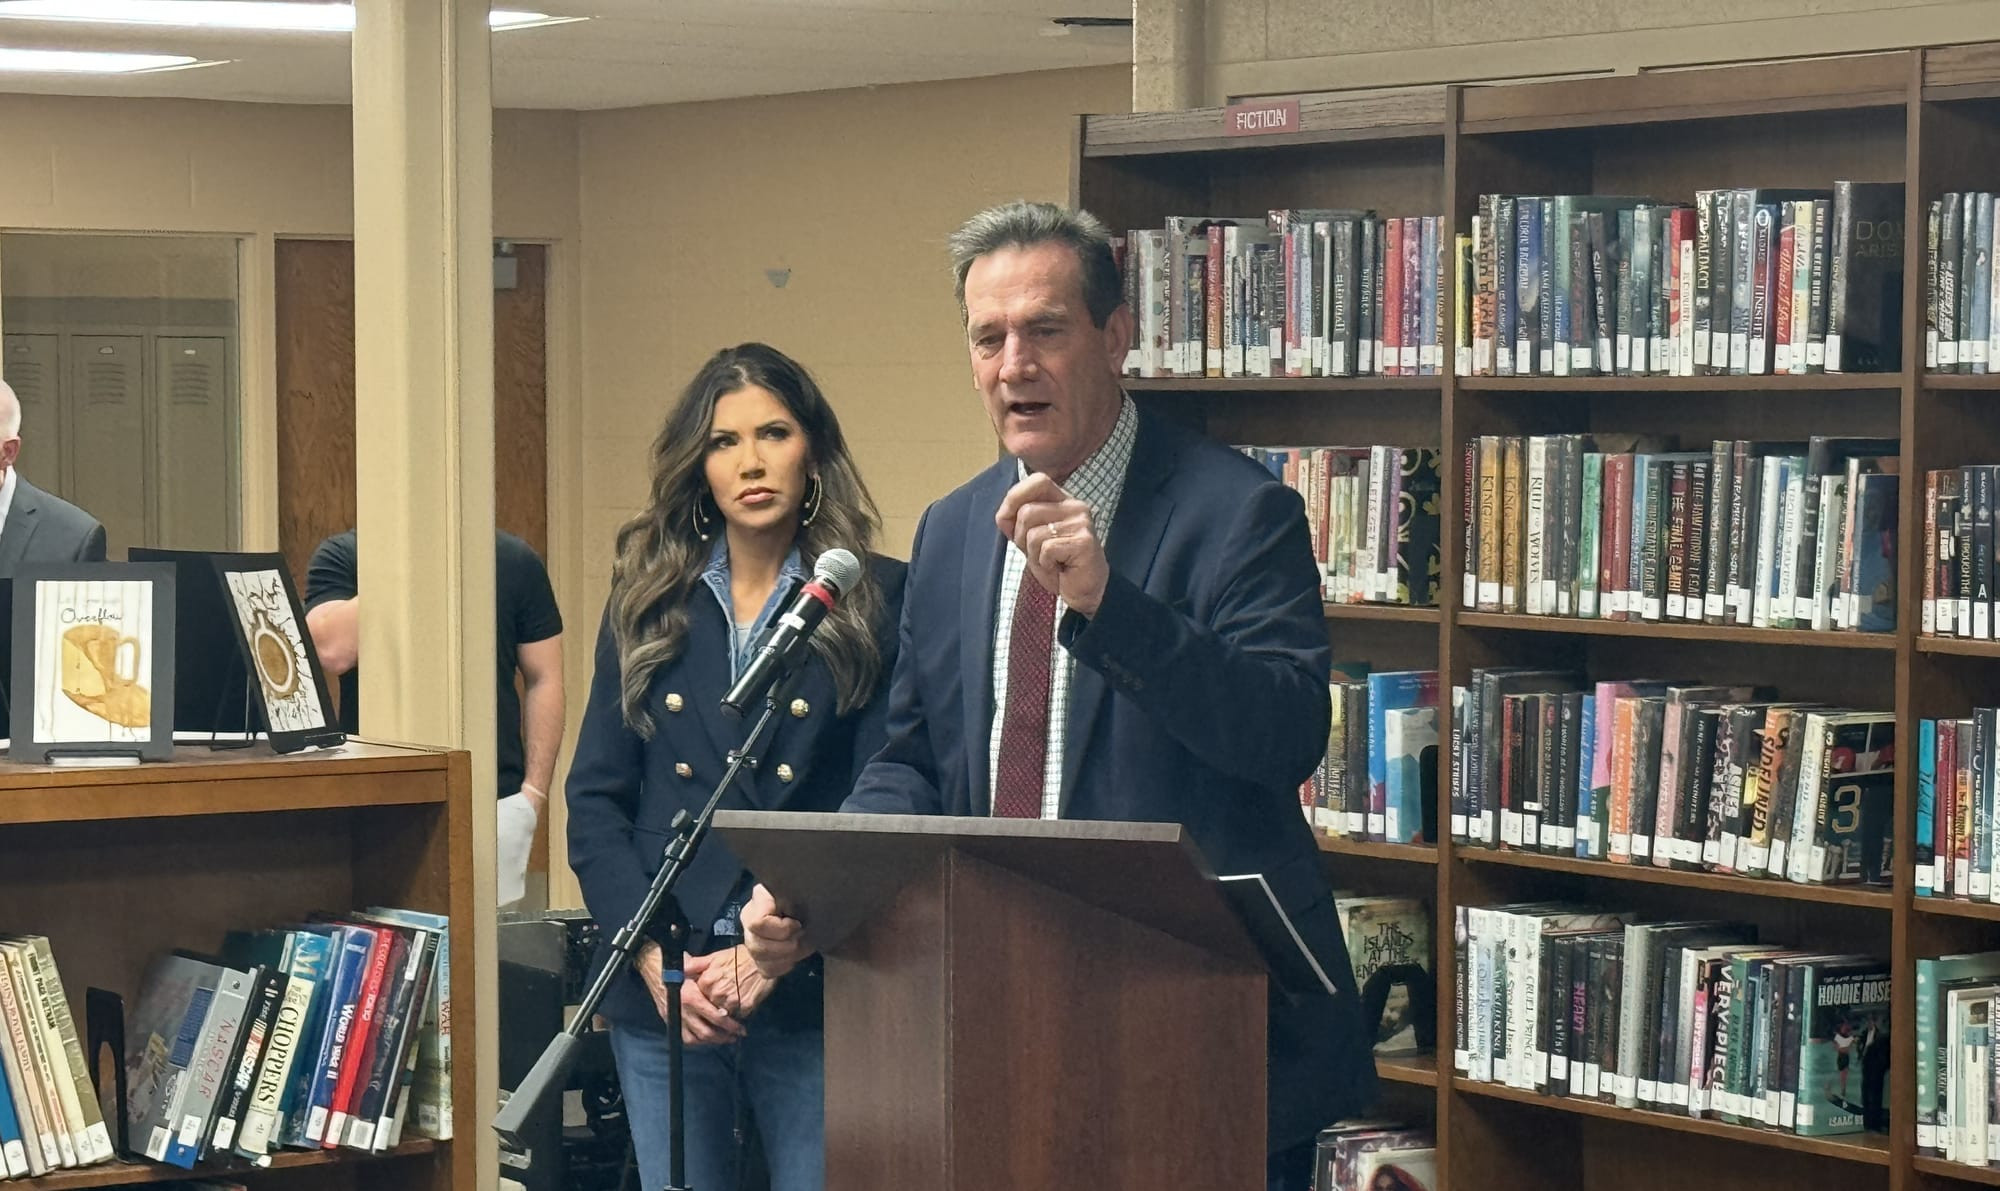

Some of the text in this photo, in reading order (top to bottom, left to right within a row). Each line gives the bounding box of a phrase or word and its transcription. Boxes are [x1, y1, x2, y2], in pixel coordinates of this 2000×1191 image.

[1236, 108, 1287, 129] FICTION
[1541, 270, 1550, 288] MAN
[1697, 234, 1710, 288] BALDACCI
[1541, 292, 1549, 321] CALLED
[1482, 475, 1494, 516] KING
[1530, 476, 1543, 511] RULE
[1644, 502, 1658, 563] INHERITANCE
[1669, 516, 1685, 551] FINAL
[1688, 481, 1705, 598] THE HAWTHORNE LEGAC
[1530, 531, 1542, 584] WOLVES
[1668, 555, 1684, 592] GAMBI
[1960, 535, 1971, 578] THROUGH
[1960, 579, 1970, 594] THE
[61, 608, 122, 625] Overflow
[1452, 729, 1461, 757] LUCKY
[1822, 748, 1831, 778] NIGHTS
[1658, 762, 1670, 812] LOVELY
[1725, 763, 1742, 818] ASHES
[1752, 736, 1775, 831] SIDELINED
[1818, 791, 1828, 825] AUGUST
[1831, 785, 1861, 833] 3
[1363, 932, 1415, 954] ISLANDS
[1377, 921, 1400, 935] THE
[1356, 963, 1378, 979] END
[1368, 948, 1410, 963] AT THE
[28, 952, 56, 1030] FRONT PAGE VIETNAM
[1574, 982, 1586, 1035] HEART
[1716, 965, 1733, 1024] VERY
[1818, 979, 1891, 1006] HOODIE ROSE
[334, 1002, 354, 1043] WORLD
[439, 1000, 449, 1035] WAR
[1493, 1020, 1502, 1051] KING
[1524, 976, 1535, 1059] CRUEL PRINCE
[8, 1007, 23, 1040] ROYAL
[16, 1039, 32, 1073] FAMILY
[197, 1017, 235, 1100] NASCAR
[256, 1004, 299, 1105] CHOPPERS
[233, 1038, 261, 1091] NASCAR
[325, 1069, 337, 1080] II
[1828, 1113, 1853, 1127] ISAAC
